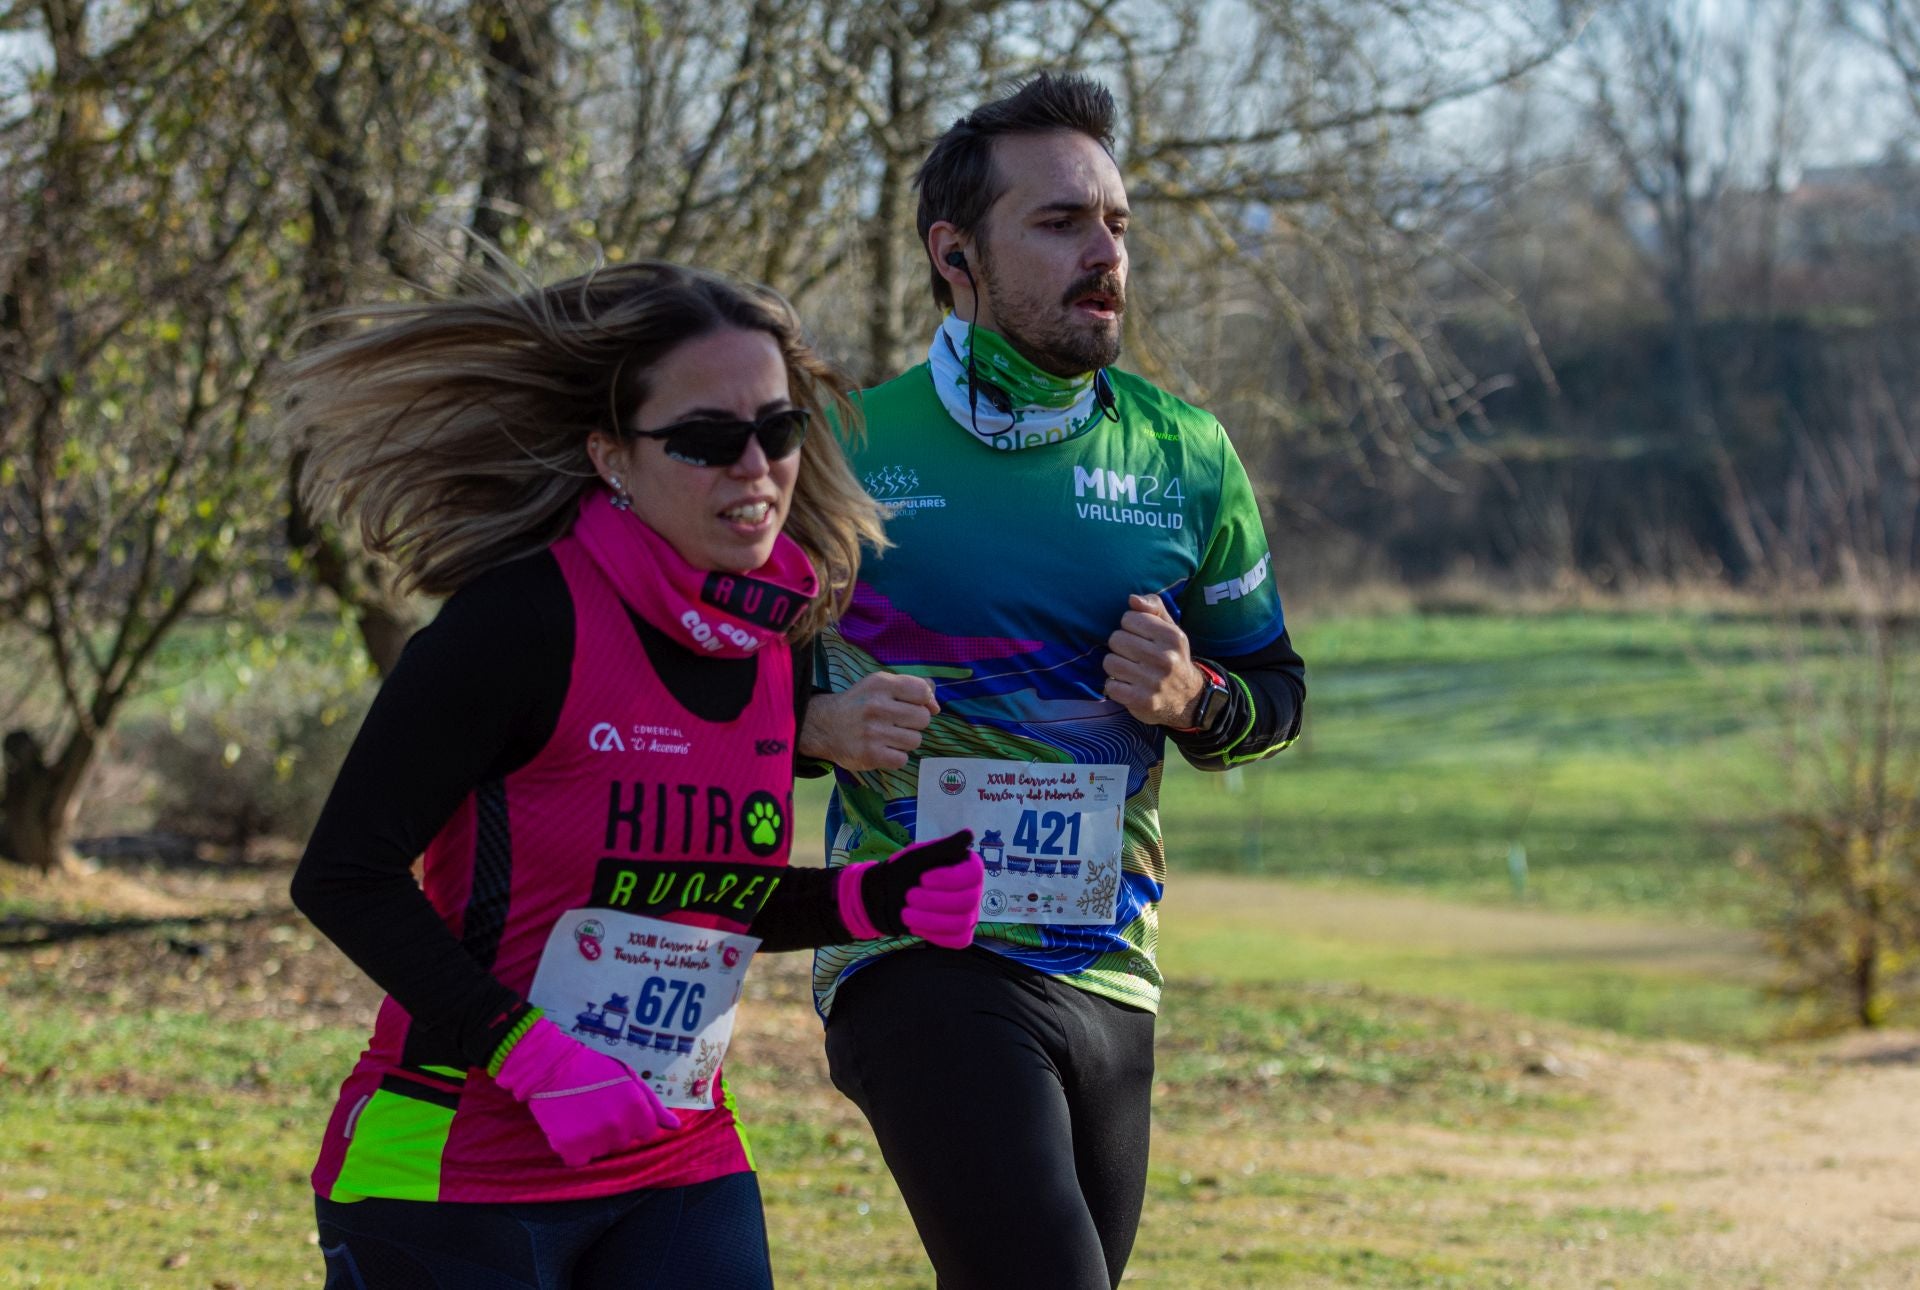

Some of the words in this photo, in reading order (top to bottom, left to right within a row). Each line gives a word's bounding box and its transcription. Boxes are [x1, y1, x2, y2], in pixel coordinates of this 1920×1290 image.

[992, 416, 1089, 450] plenit
[1074, 465, 1186, 508] MM24
[1076, 503, 1184, 530] VALLADOLID
[714, 576, 809, 626] RUN
[633, 724, 684, 738] COMERCIAL
[1014, 793, 1025, 805] y
[1013, 809, 1082, 856] 421
[635, 976, 706, 1032] 676
